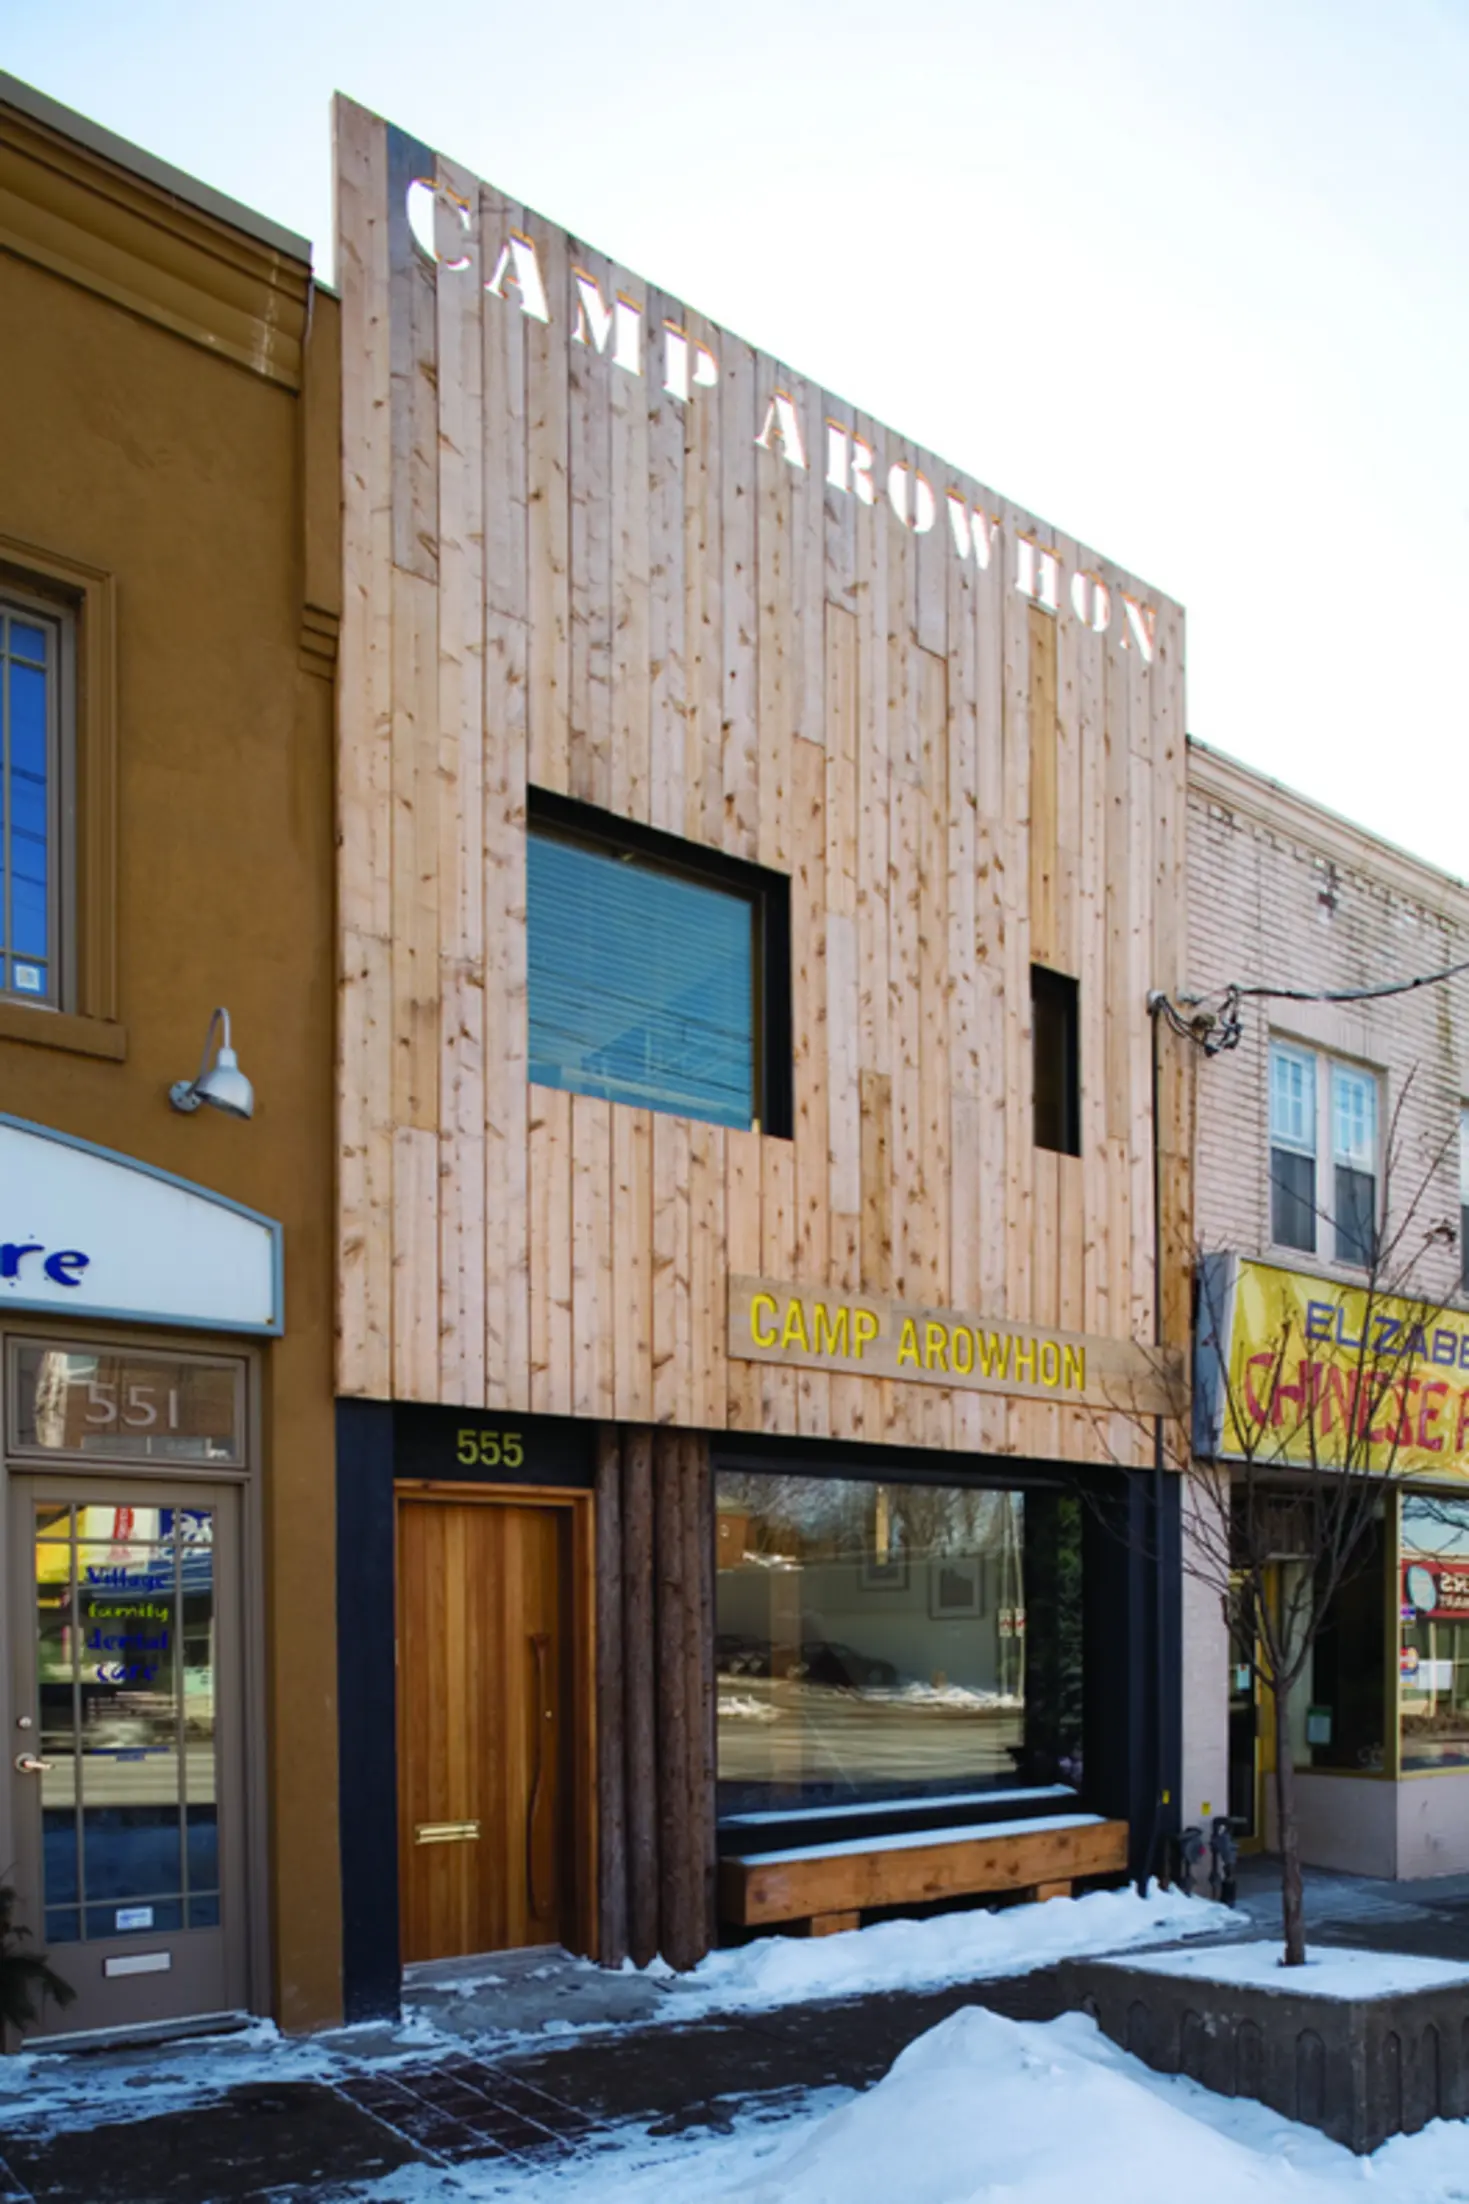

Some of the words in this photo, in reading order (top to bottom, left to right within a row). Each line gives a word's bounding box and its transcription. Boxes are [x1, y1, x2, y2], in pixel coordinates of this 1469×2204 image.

[405, 176, 718, 403] CAMP
[754, 388, 1157, 664] AROWHON
[749, 1292, 878, 1360] CAMP
[896, 1317, 1086, 1392] AROWHON
[84, 1381, 178, 1428] 551
[456, 1429, 523, 1468] 555
